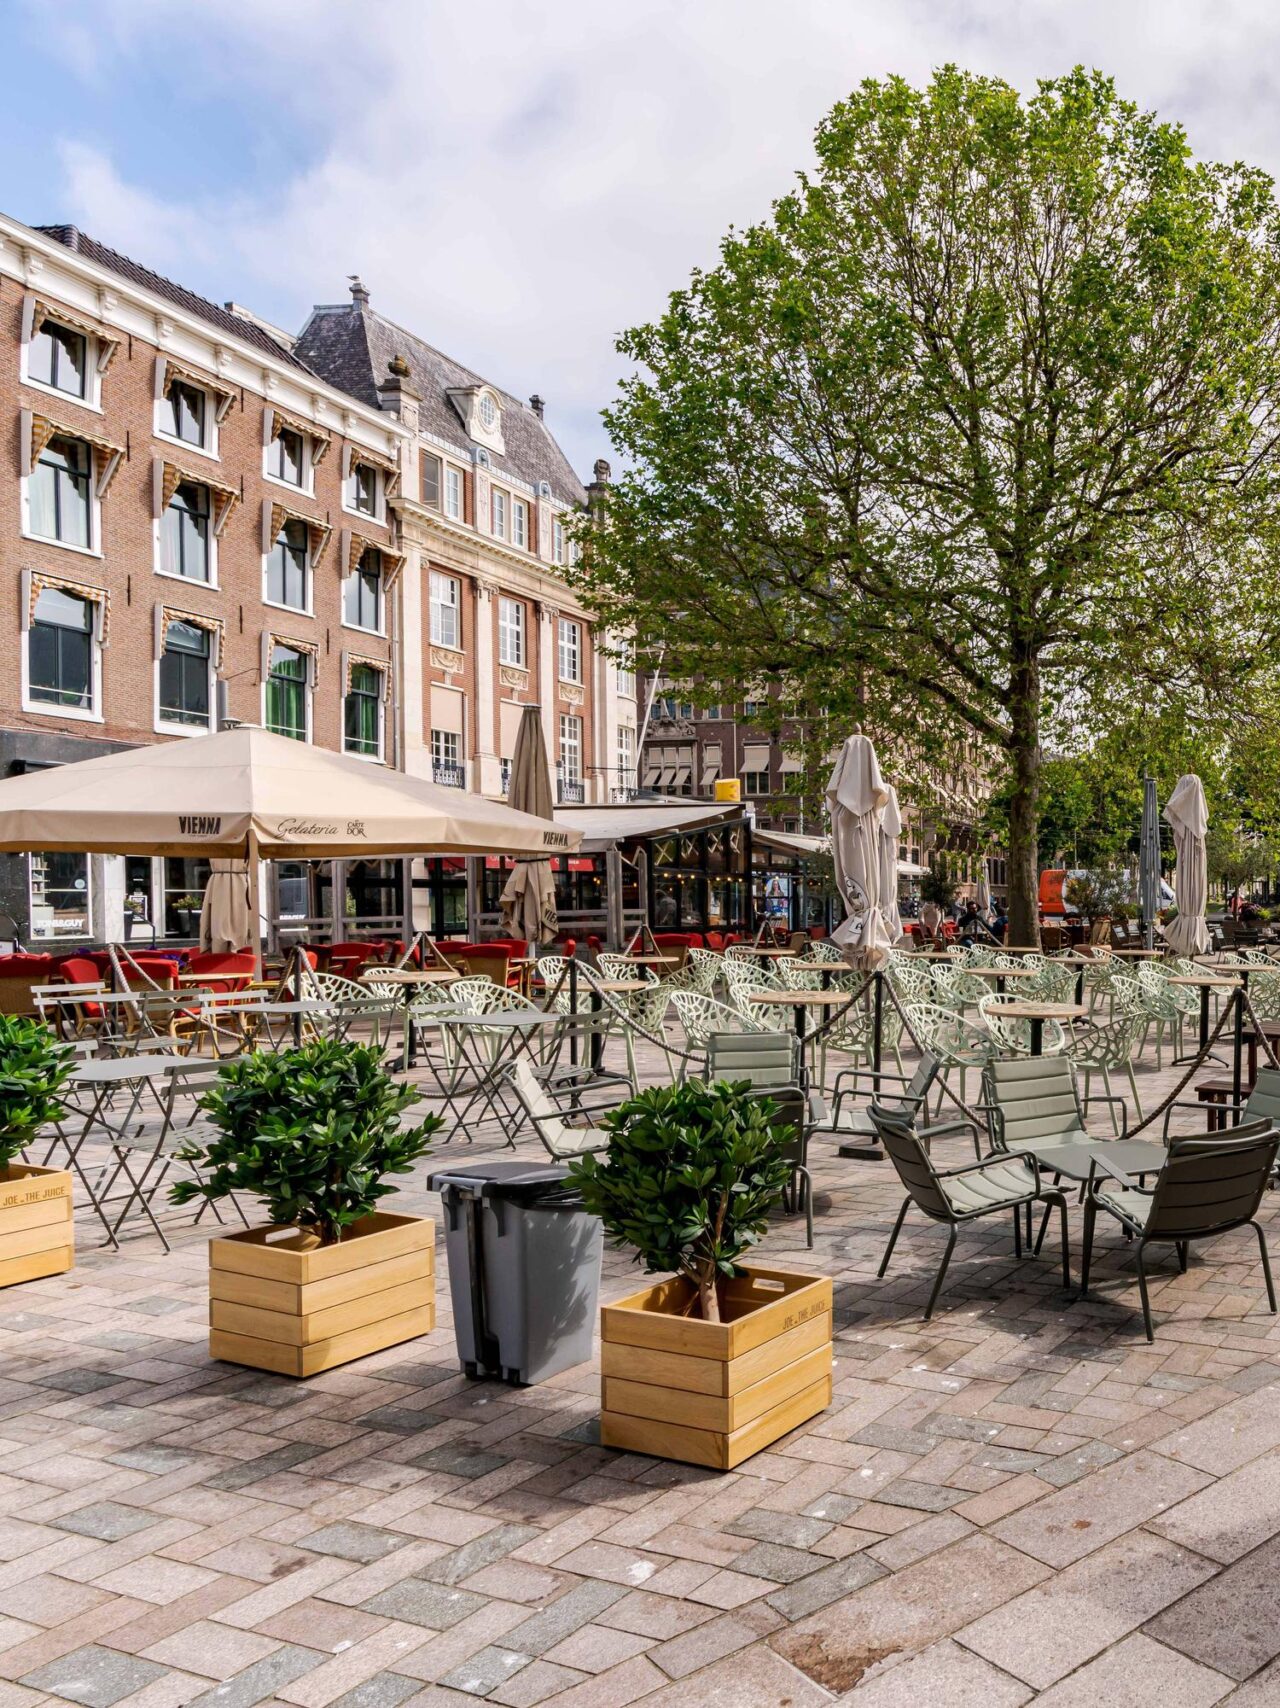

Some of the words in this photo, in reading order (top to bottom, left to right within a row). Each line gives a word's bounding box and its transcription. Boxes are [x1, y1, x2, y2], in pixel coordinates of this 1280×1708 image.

[178, 816, 221, 835] VIENNA
[274, 818, 339, 838] Gelateria
[543, 831, 569, 846] VIENNA
[2, 1195, 19, 1206] JOE
[25, 1191, 39, 1202] THE
[42, 1186, 65, 1199] JUICE
[782, 1315, 794, 1330] JOE
